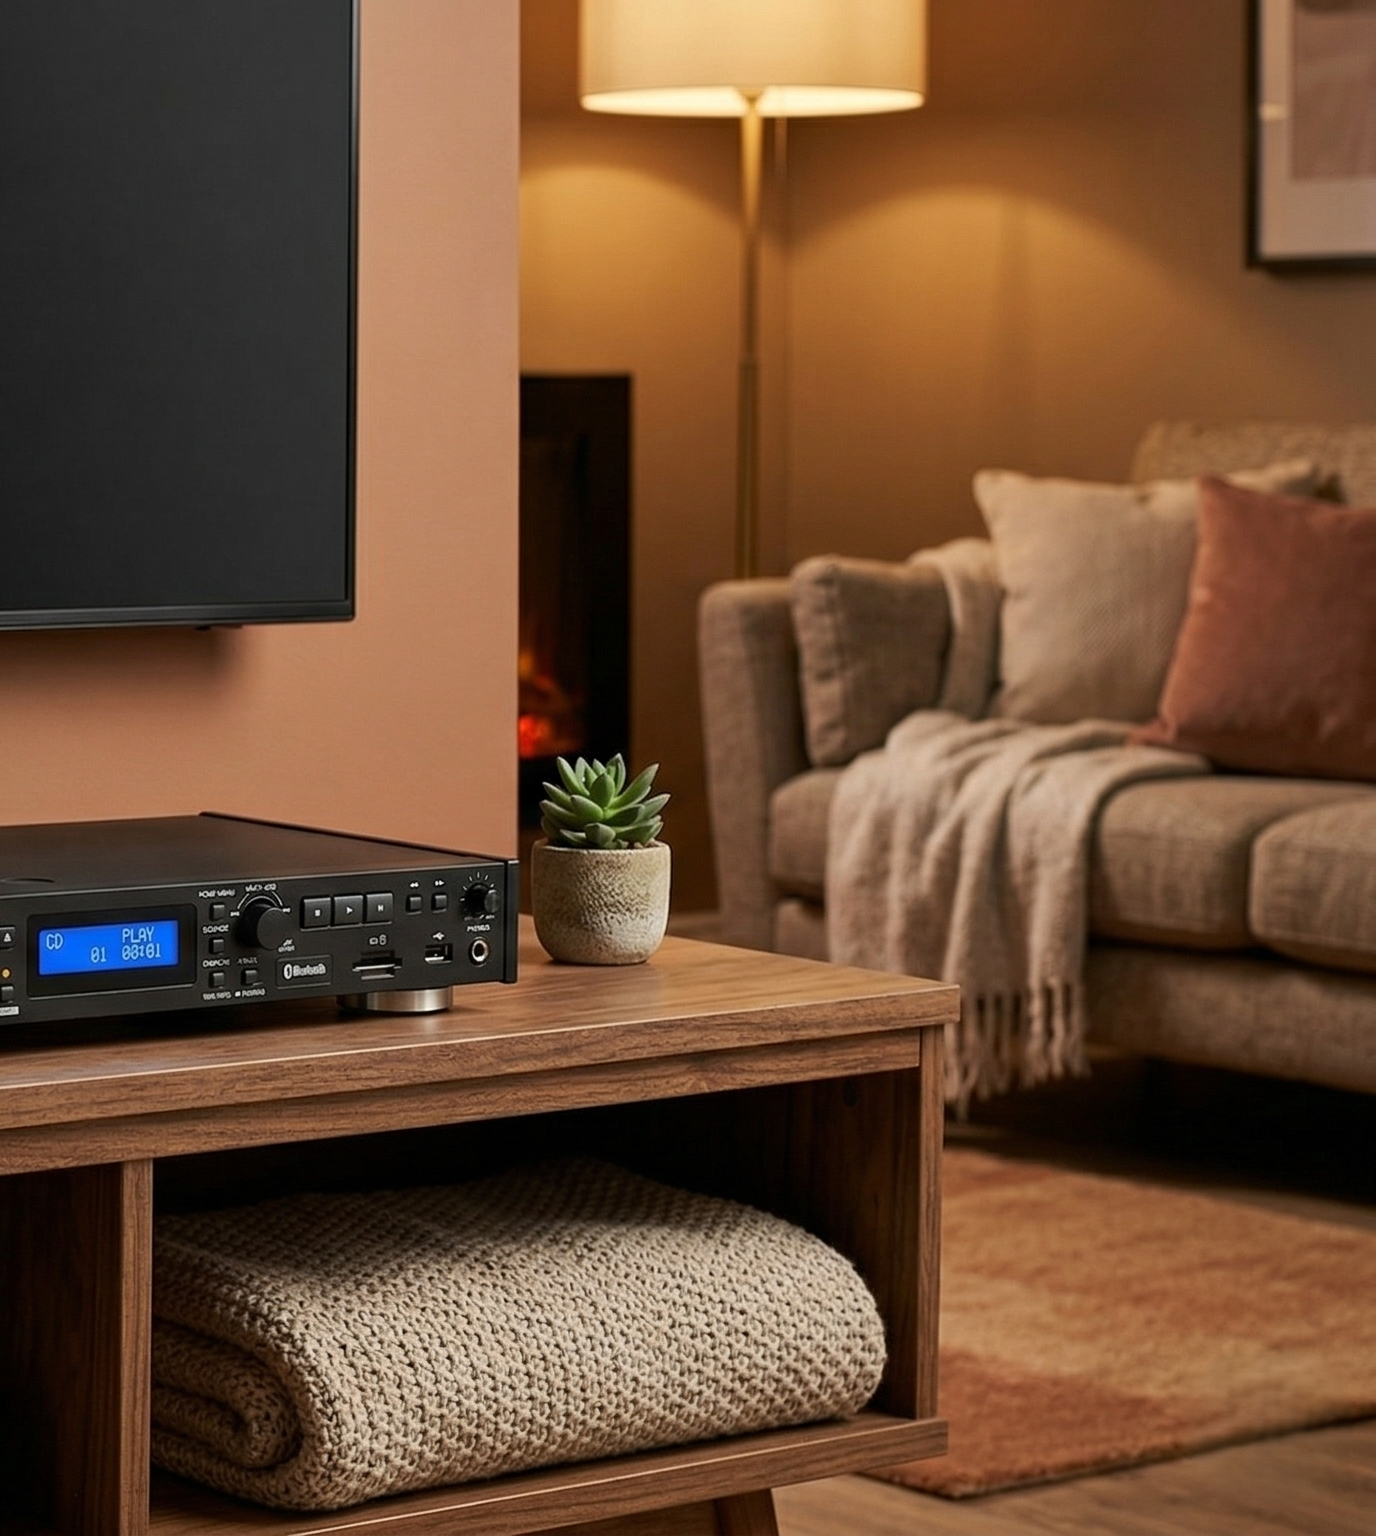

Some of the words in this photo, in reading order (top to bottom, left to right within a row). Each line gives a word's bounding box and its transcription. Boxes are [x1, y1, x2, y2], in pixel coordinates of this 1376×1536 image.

[46, 933, 63, 950] CD
[122, 926, 155, 943] PLAY
[90, 946, 107, 963] 01
